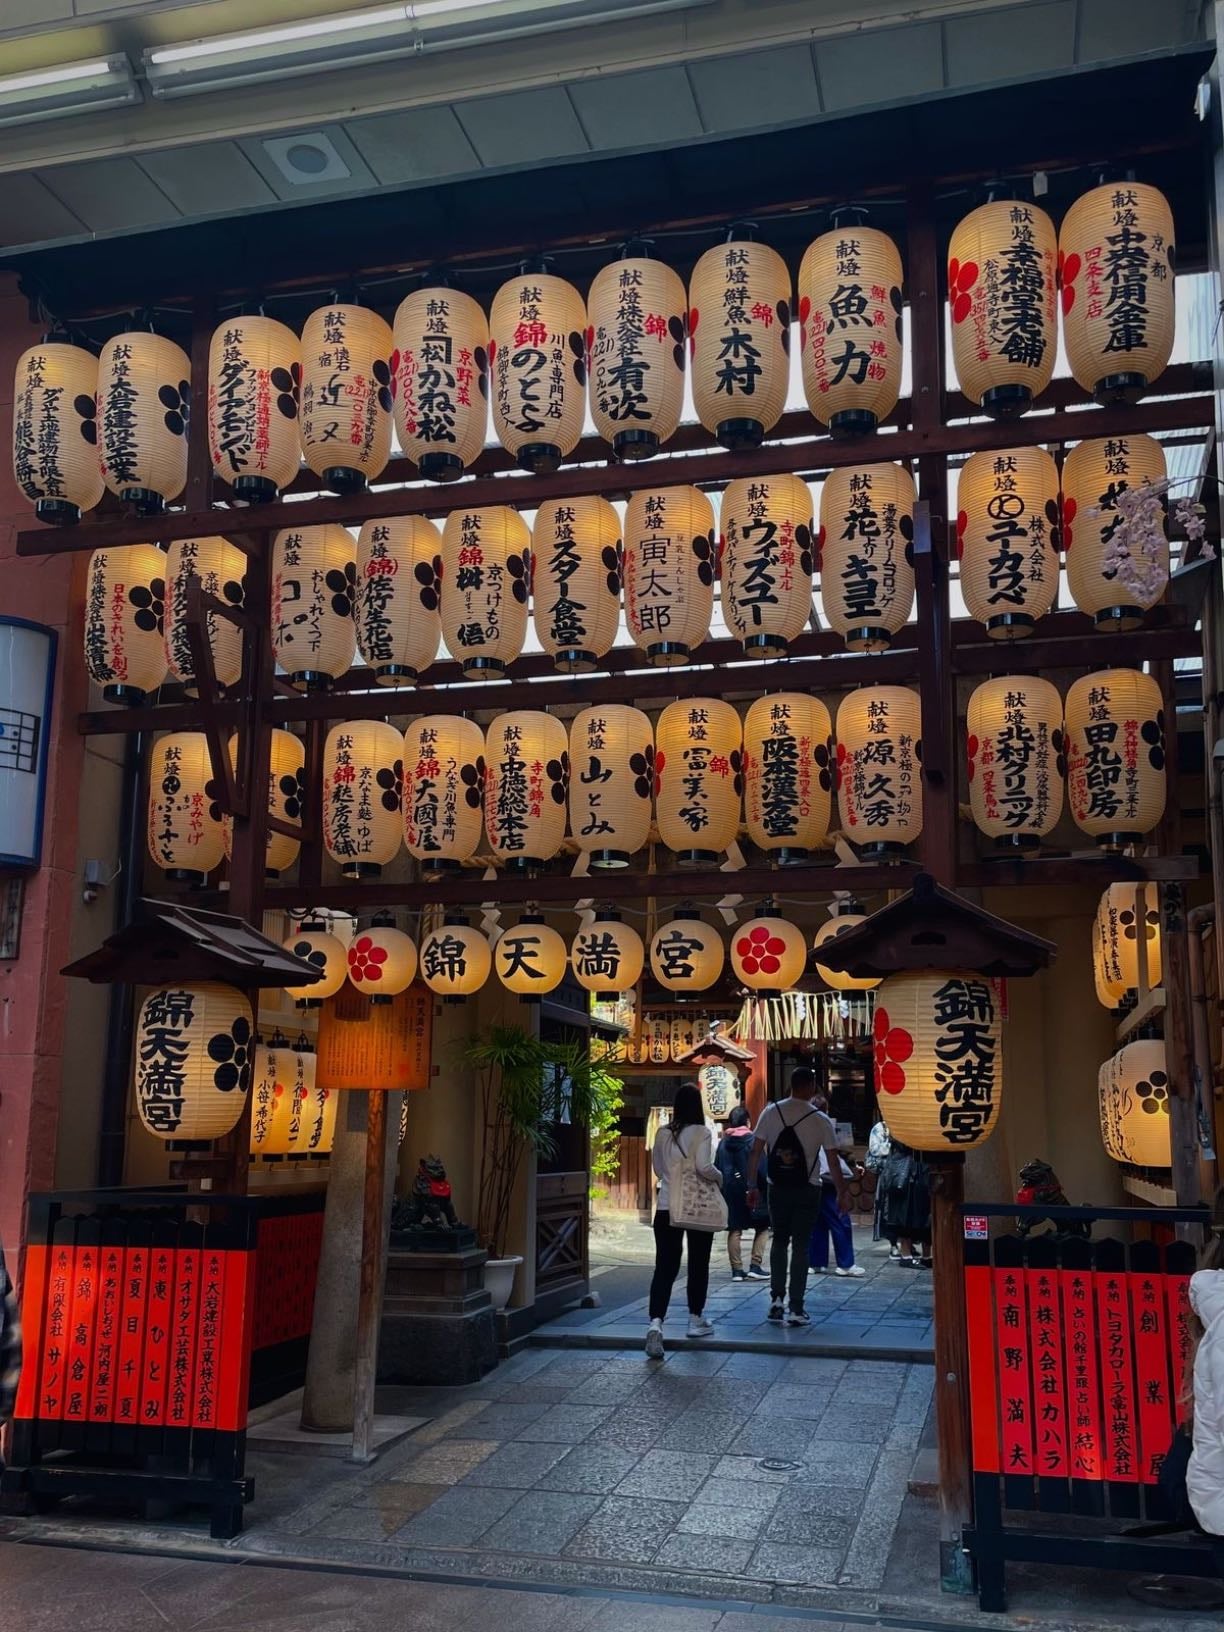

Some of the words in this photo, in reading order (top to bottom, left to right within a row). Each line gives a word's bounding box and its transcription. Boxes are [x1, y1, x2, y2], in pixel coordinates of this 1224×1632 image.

[1102, 227, 1150, 353] 中央信用金庫
[1151, 233, 1167, 282] 京都
[513, 320, 549, 348] 錦
[643, 313, 668, 344] 錦
[722, 286, 752, 326] 鮮魚
[752, 302, 773, 329] 錦
[826, 284, 874, 385] 魚力
[998, 242, 1046, 367] 幸福堂老舗
[319, 352, 332, 368] 宿
[456, 348, 473, 406] 京野菜
[511, 348, 548, 433] のとよ
[544, 333, 566, 419] 川魚専門店
[607, 357, 652, 421] 有次
[714, 328, 762, 396] 木村
[104, 377, 141, 484] 大岩建設工業
[218, 361, 251, 473] ダイアモンド
[245, 368, 257, 444] ファッションビル
[415, 364, 456, 443] かね松
[458, 547, 484, 566] 錦
[637, 534, 672, 633] 寅太郎
[739, 517, 780, 626] ウィズユー
[779, 519, 795, 591] 寺町錦上ル
[1028, 515, 1046, 582] 株式会社
[308, 569, 326, 652] おしゃれくつ下
[362, 577, 395, 660] 佐竹生花店
[485, 563, 504, 640] 京つけもの
[548, 540, 586, 647] スター食堂
[333, 765, 356, 784] 錦
[415, 759, 440, 779] 錦
[529, 760, 544, 817] 寺町錦角
[580, 755, 615, 836] 山とみ
[709, 755, 729, 779] 錦
[761, 736, 799, 838] 阪本漢方堂
[996, 725, 1035, 828] 北村クリニック
[1084, 722, 1123, 819] 田丸印房
[188, 793, 204, 846] 京みやげ
[414, 779, 441, 851] 大國屋
[424, 935, 467, 981] 錦
[502, 936, 547, 980] 天
[576, 932, 622, 980] 満
[656, 930, 704, 979] 宮
[138, 990, 195, 1132] 錦天満宮
[705, 1064, 729, 1115] 錦天満宮
[933, 979, 997, 1144] 錦天満宮
[120, 1278, 142, 1418] 夏目千夏
[198, 1281, 221, 1422] 大岩建設工業株式会社
[1036, 1304, 1062, 1469] 株式会社カハラ
